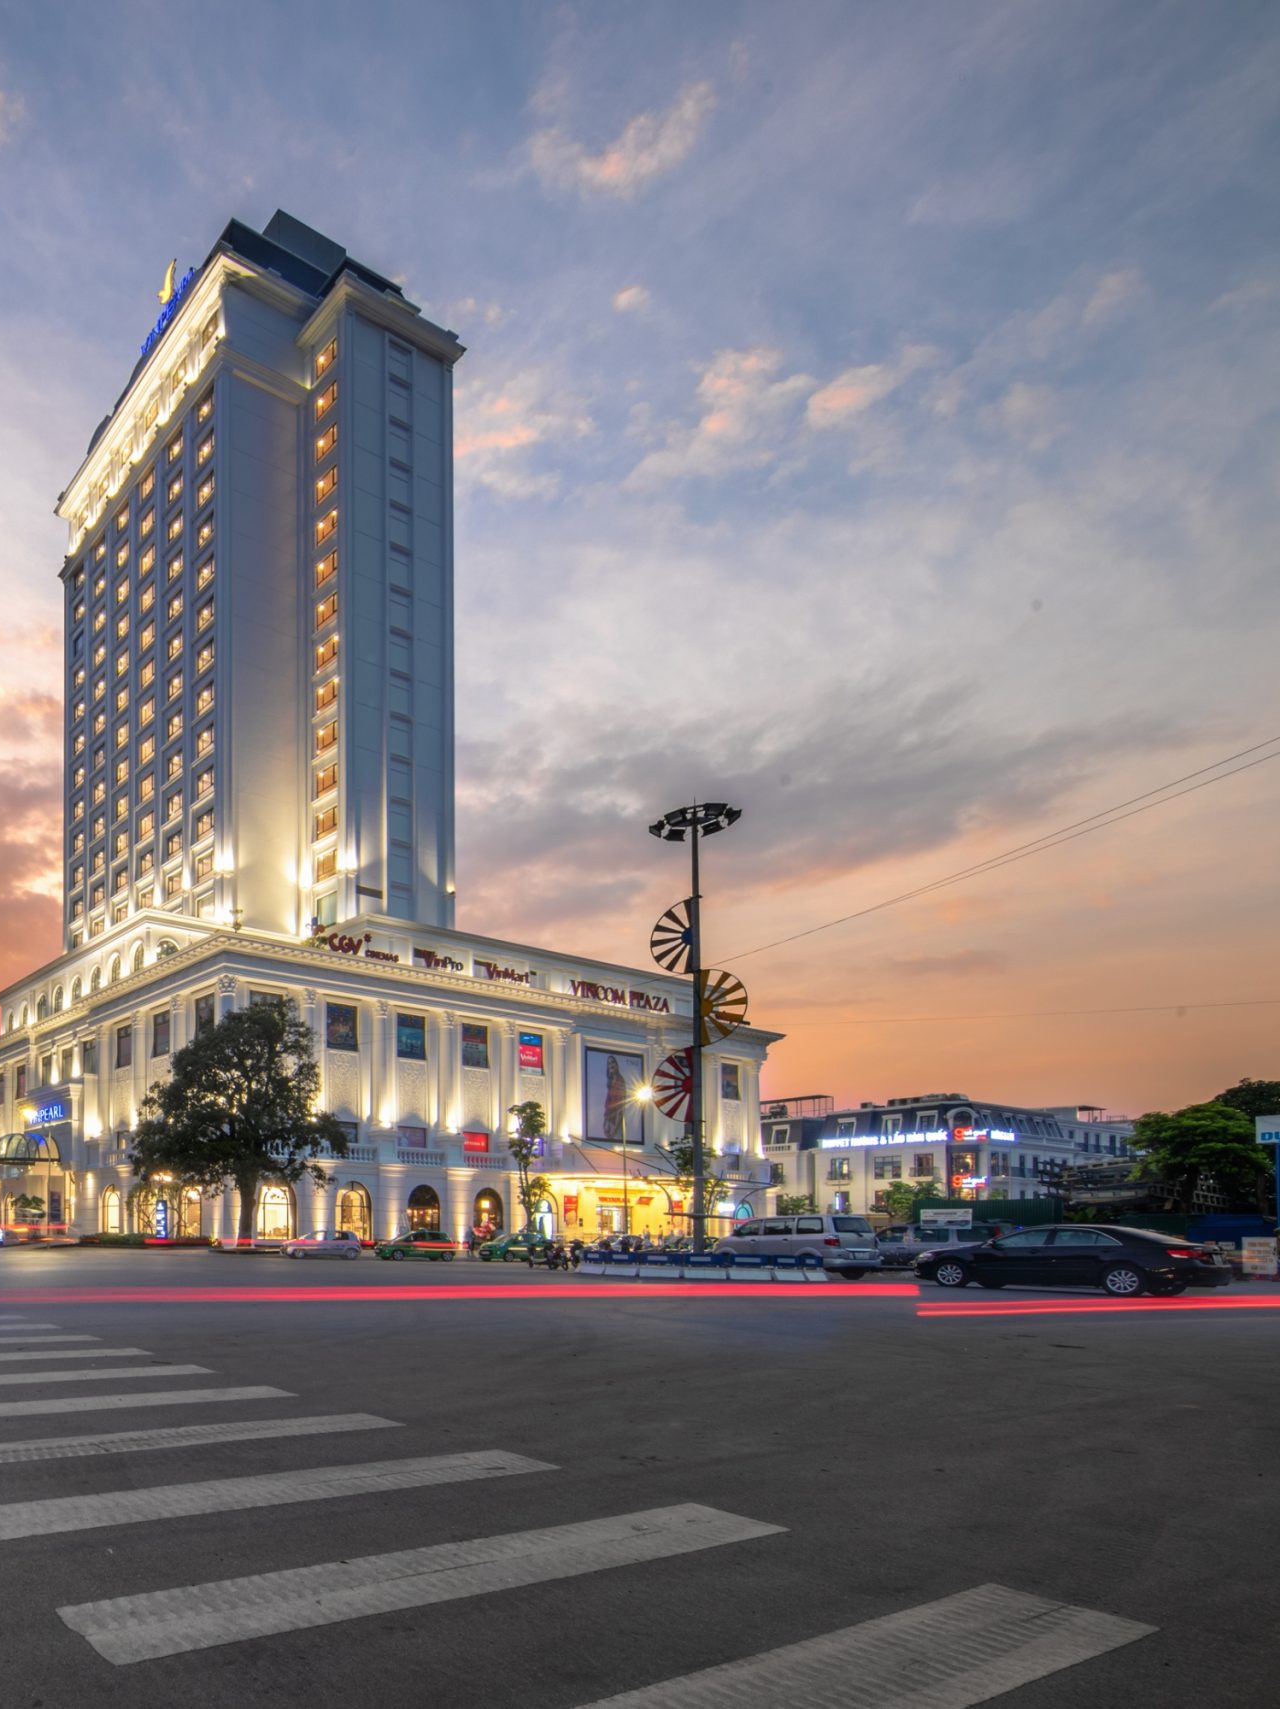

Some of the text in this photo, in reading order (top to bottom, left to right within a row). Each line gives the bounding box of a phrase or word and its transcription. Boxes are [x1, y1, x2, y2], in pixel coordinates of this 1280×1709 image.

[328, 932, 363, 955] CGV
[423, 950, 464, 971] VinPro
[485, 962, 529, 983] VinMart
[569, 980, 670, 1013] VINCOM PLAZA
